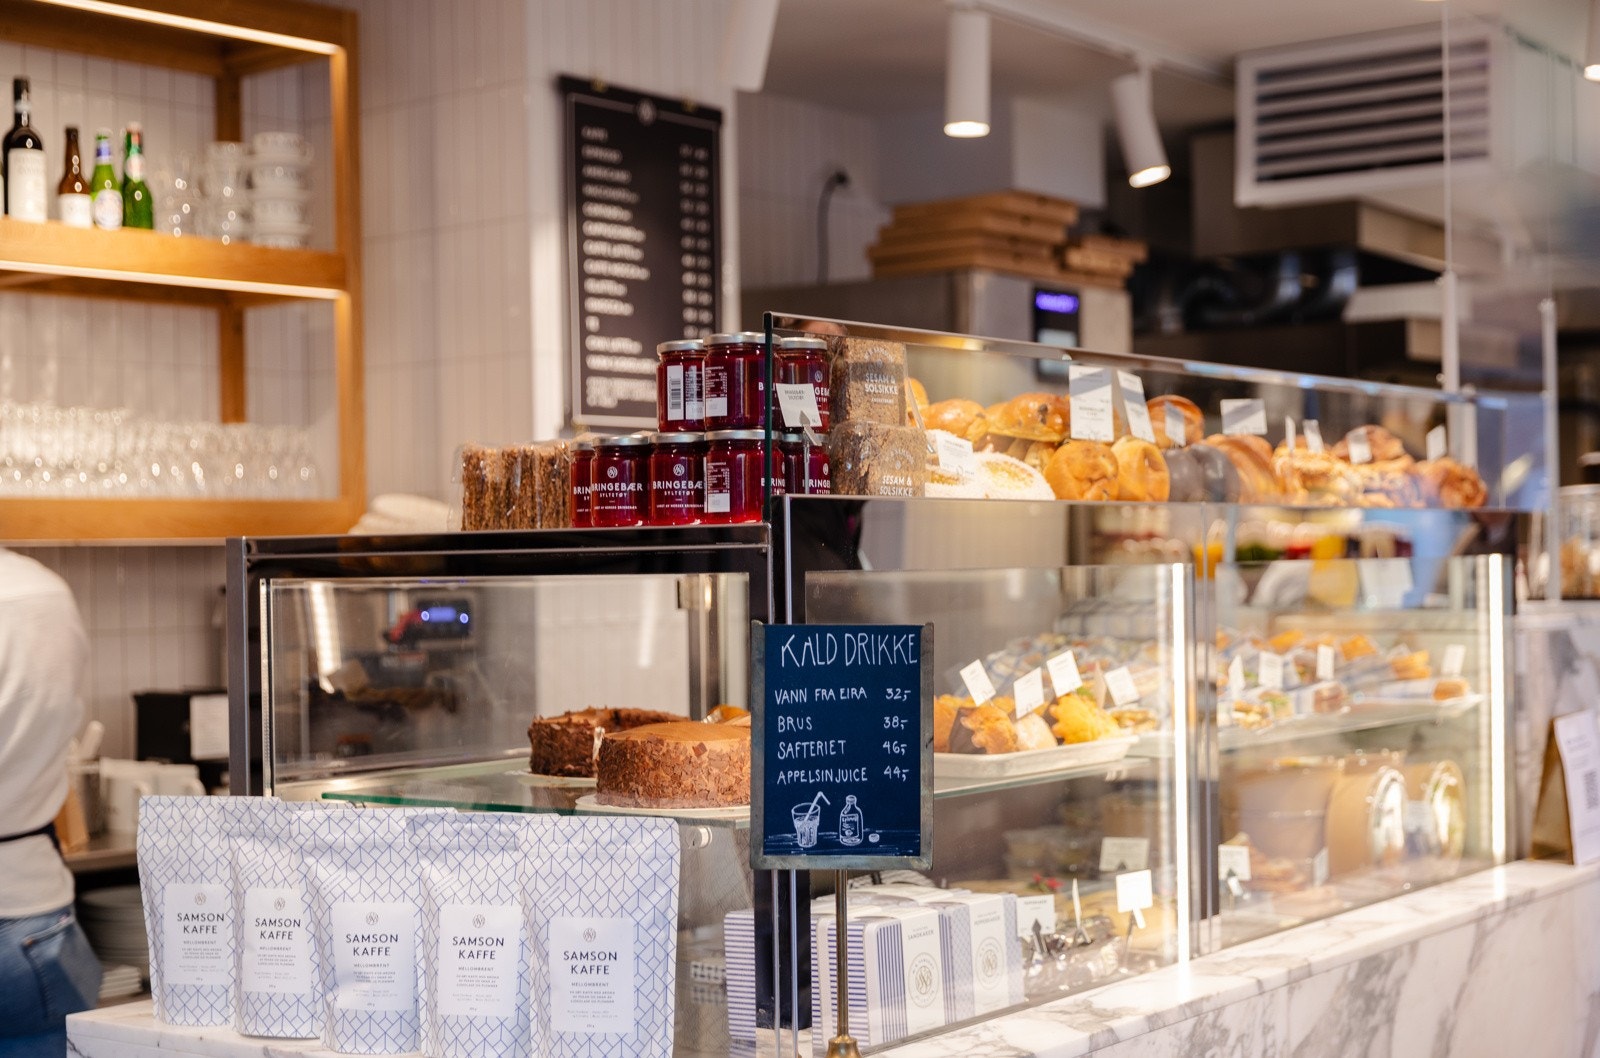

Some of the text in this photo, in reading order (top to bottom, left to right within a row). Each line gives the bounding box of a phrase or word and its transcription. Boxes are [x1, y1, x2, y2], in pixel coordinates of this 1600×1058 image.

[865, 372, 896, 384] SESAM &
[864, 383, 898, 395] SOLSIKKE
[653, 480, 703, 490] BRINGEBÆ
[882, 475, 912, 486] SESAM &
[573, 486, 591, 495] BRIN
[591, 482, 643, 491] BRINGEBÆR
[880, 486, 913, 497] SOLSIKKE
[781, 632, 918, 668] KALD DRIKKE
[775, 688, 807, 704] VANN
[815, 687, 836, 702] FRA
[840, 686, 867, 700] EIRA
[777, 716, 813, 733] BRUS
[777, 739, 846, 760] SAFTERIET
[777, 767, 868, 786] APPELSINJUICE
[177, 912, 225, 922] SAMSON
[255, 917, 301, 928] SAMSON
[183, 925, 217, 934] KAFFE
[260, 930, 293, 940] KAFFE
[345, 933, 399, 943] SAMSON
[452, 936, 505, 947] SAMSON
[353, 946, 391, 957] KAFFE
[458, 949, 496, 960] KAFFE
[563, 950, 617, 961] SAMSON
[571, 964, 610, 975] KAFFE
